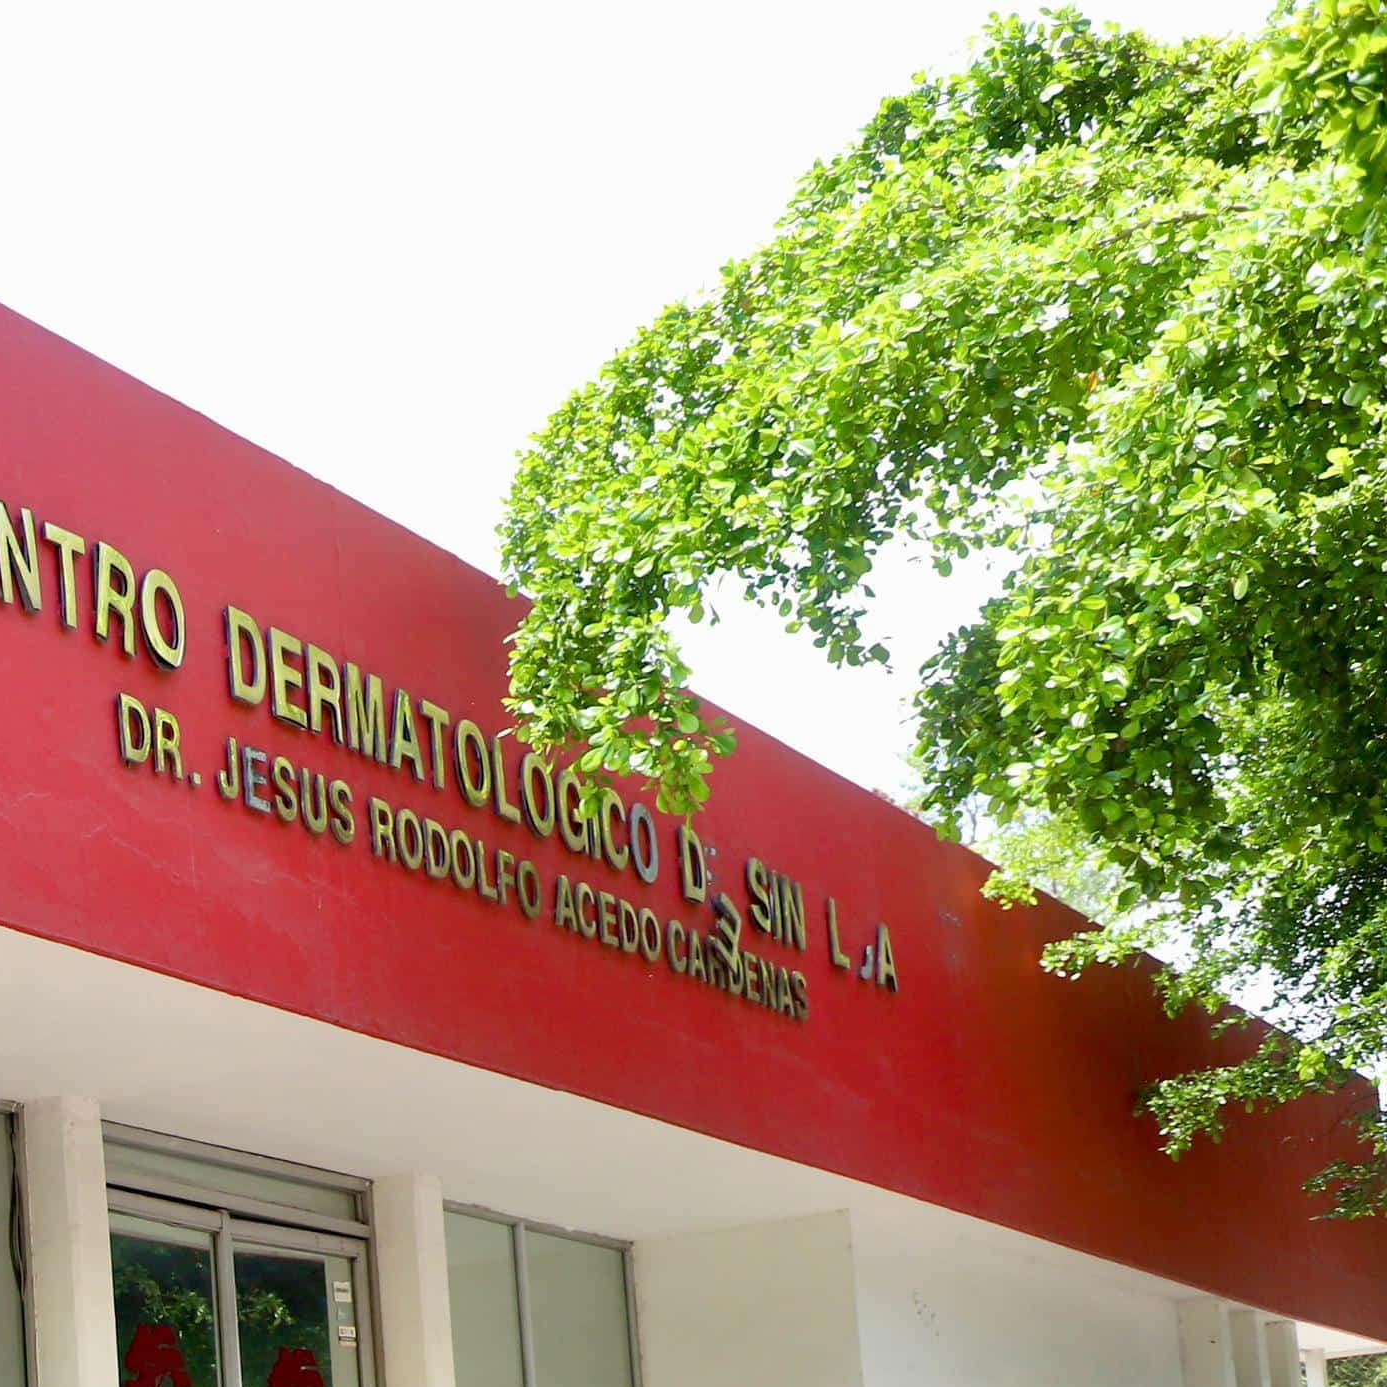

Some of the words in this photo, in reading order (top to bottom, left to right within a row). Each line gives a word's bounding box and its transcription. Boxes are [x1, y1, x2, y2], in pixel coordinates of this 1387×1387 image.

[118, 693, 202, 787] DR.
[217, 737, 355, 845] JESUS
[369, 796, 543, 919] RODOLFO
[555, 874, 661, 962] ACEDO
[225, 604, 659, 884] DERMATOLOGICO
